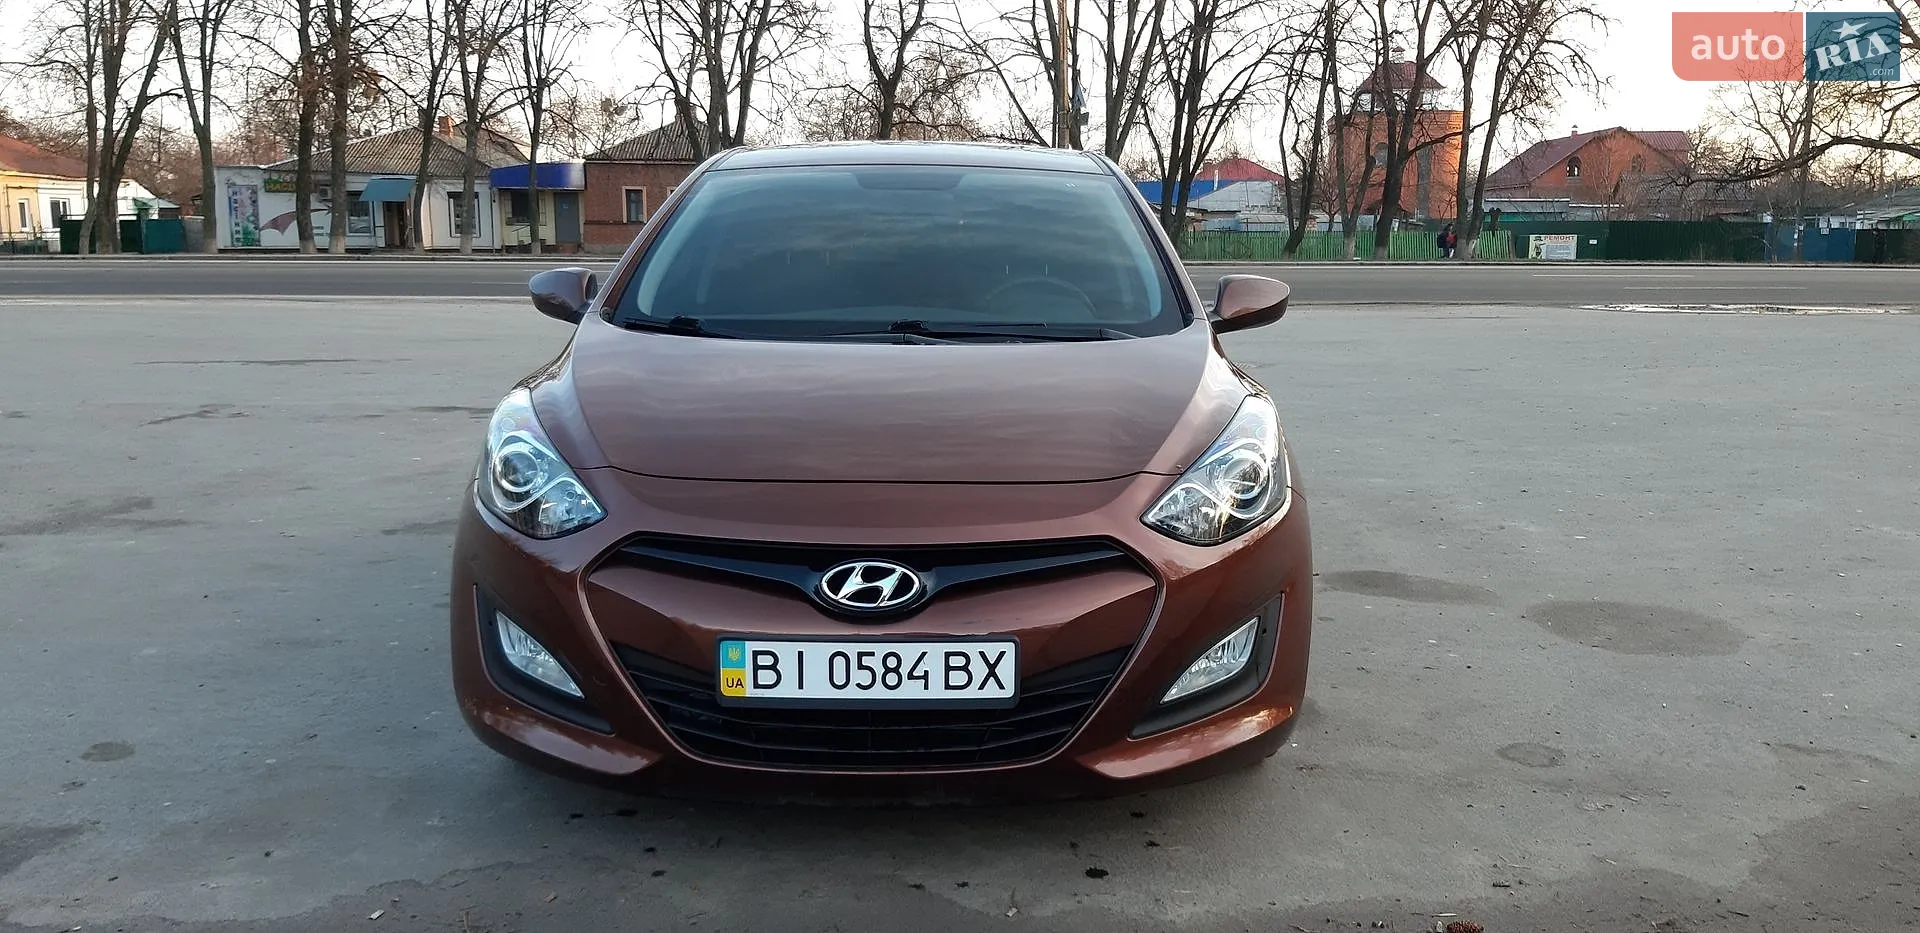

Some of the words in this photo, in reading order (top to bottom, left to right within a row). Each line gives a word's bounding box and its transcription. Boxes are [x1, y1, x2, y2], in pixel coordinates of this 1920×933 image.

[726, 677, 744, 689] UA
[752, 650, 804, 690] BI
[828, 650, 930, 691] 0584
[943, 651, 1007, 691] BX
